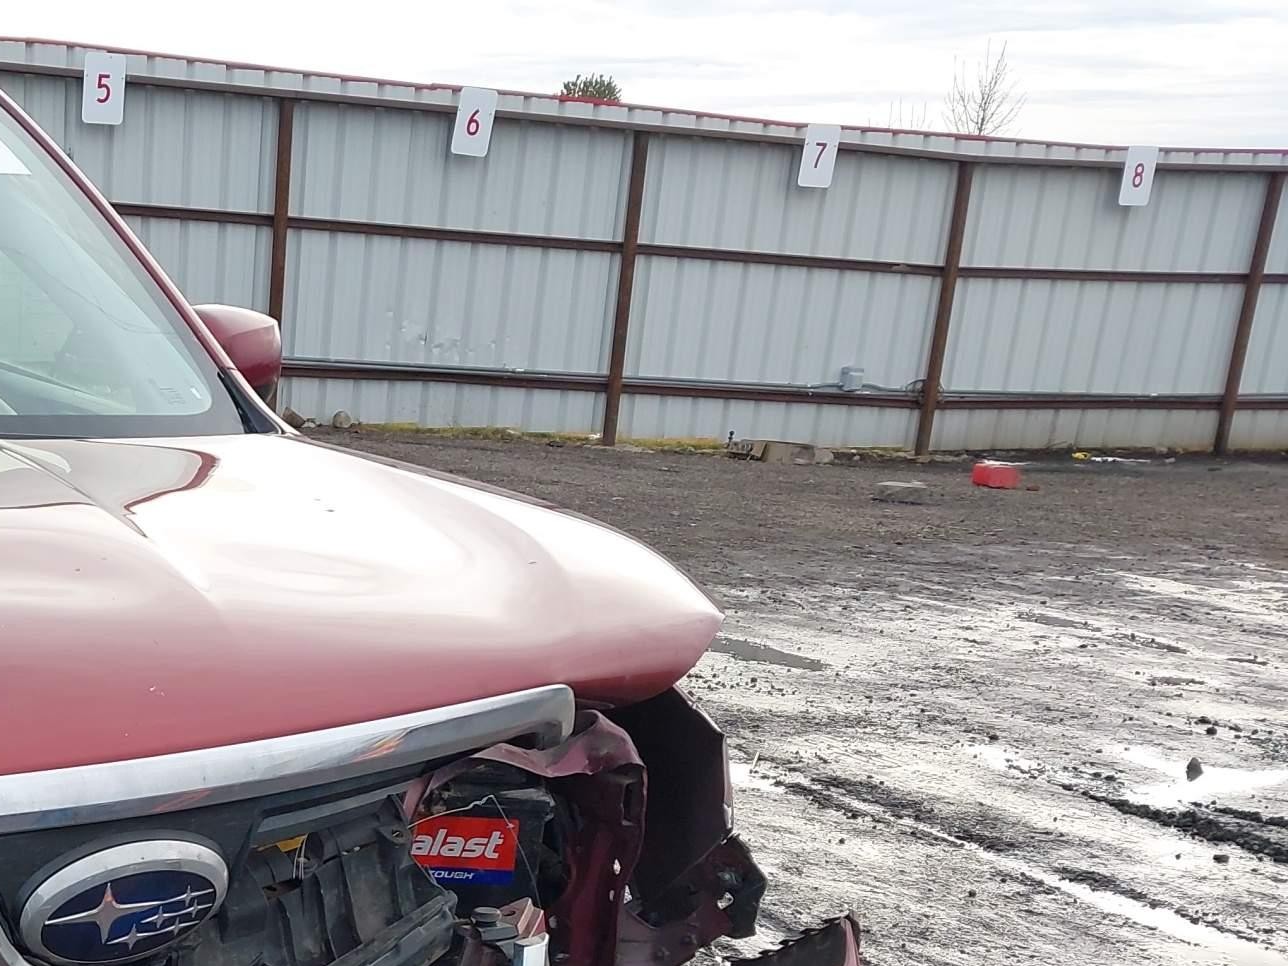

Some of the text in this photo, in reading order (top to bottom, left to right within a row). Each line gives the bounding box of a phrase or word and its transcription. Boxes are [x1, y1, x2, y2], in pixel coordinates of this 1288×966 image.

[96, 73, 112, 104] 5
[466, 109, 481, 137] 6
[814, 142, 828, 170] 7
[1132, 162, 1145, 189] 8
